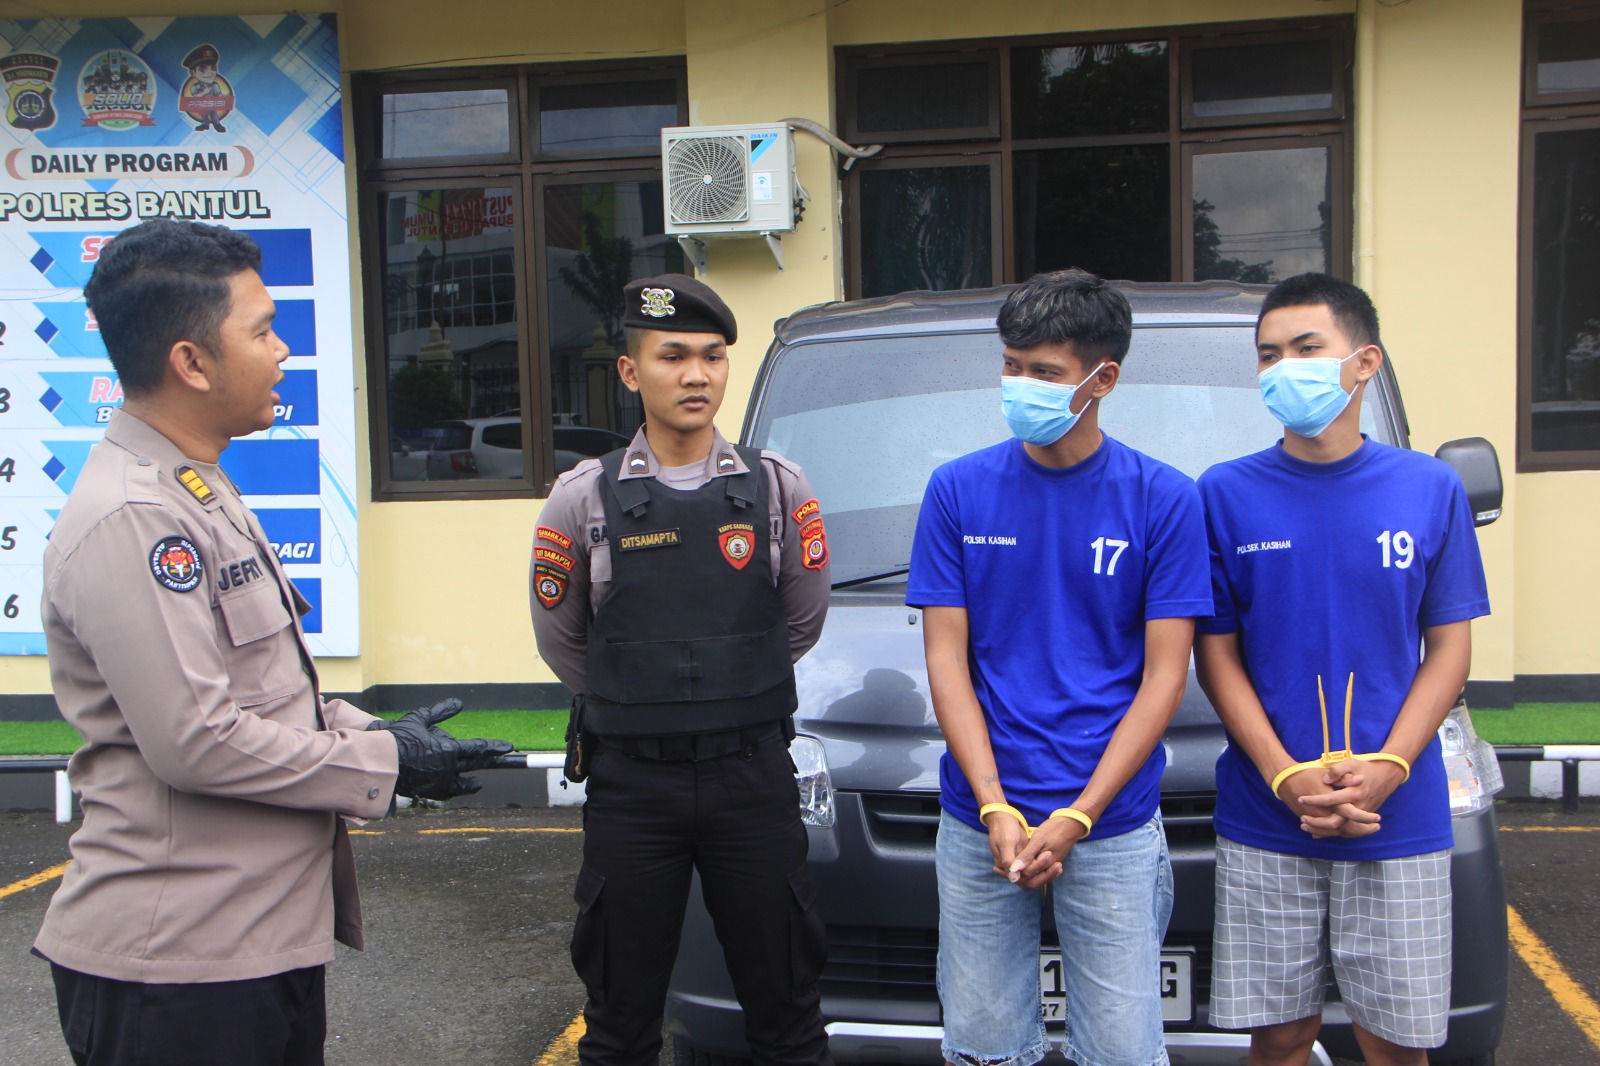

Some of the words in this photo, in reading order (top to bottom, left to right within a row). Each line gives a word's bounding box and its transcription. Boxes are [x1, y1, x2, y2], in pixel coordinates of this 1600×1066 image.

[31, 154, 97, 173] DAILY
[105, 152, 228, 172] PROGRAM
[0, 192, 132, 221] POLRES
[136, 190, 271, 219] BANTUL
[0, 457, 16, 483] 4
[1, 526, 18, 550] 5
[621, 532, 678, 549] DITSAMAPTA
[963, 535, 987, 545] POLSEK
[988, 536, 1017, 546] KASIHAN
[1236, 542, 1260, 555] POLSEK
[1261, 539, 1292, 551] KASIHAN
[1376, 530, 1415, 570] 19
[1090, 536, 1129, 576] 17
[4, 594, 20, 619] 6
